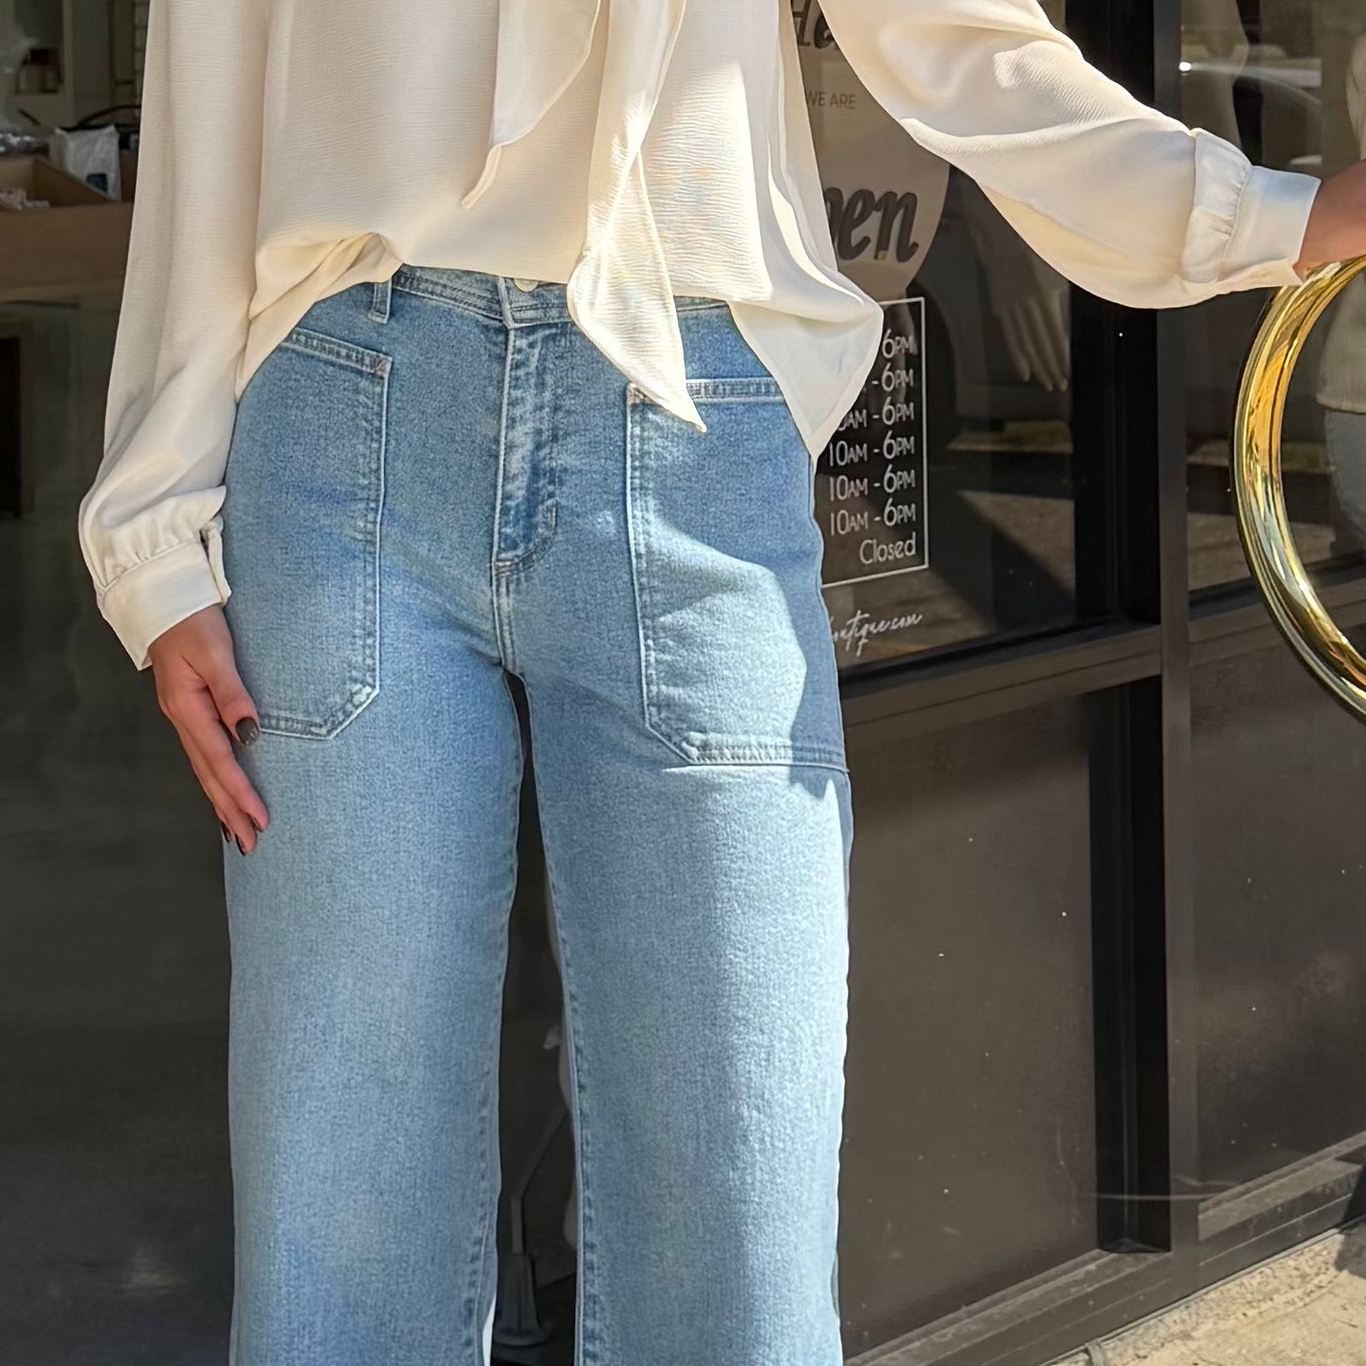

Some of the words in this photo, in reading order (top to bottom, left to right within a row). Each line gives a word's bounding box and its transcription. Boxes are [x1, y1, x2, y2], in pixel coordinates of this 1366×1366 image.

[829, 93, 857, 110] ARE
[881, 362, 914, 392] 6PM
[837, 409, 867, 431] AM
[882, 396, 915, 425] 6PM
[829, 440, 868, 467] 10AM
[882, 430, 915, 459] 6PM
[830, 475, 868, 501] 10AM
[883, 464, 915, 493] 6PM
[831, 509, 869, 536] 10AM
[883, 497, 916, 527] 6PM
[859, 531, 916, 564] Closed
